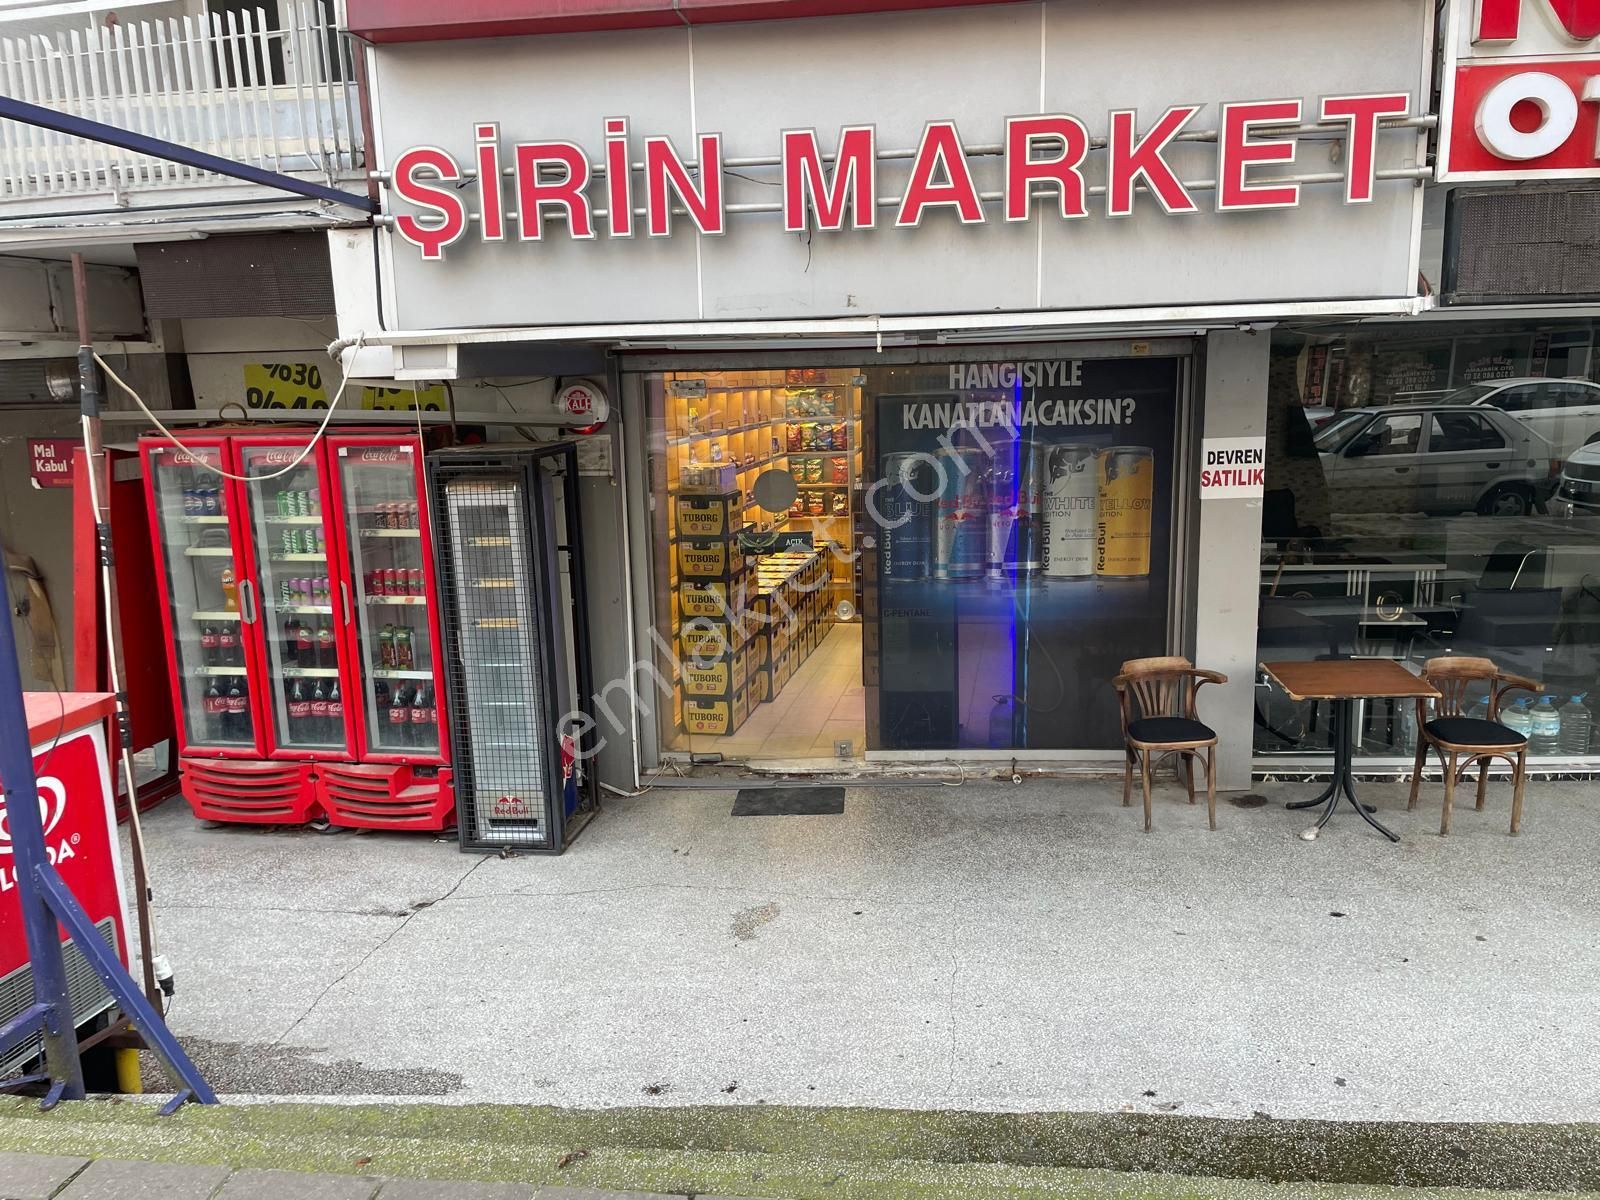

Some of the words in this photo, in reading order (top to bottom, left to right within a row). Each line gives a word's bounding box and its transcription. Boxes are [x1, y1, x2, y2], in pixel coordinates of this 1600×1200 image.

[1474, 71, 1600, 161] O
[391, 115, 726, 262] ŞİRİN
[780, 90, 1411, 233] MARKET
[903, 398, 1136, 430] KANATLANACAKSIN?
[34, 444, 55, 458] Mal
[1207, 449, 1263, 466] DEVREN
[36, 459, 68, 472] Kabul
[1201, 468, 1264, 487] SATILIK
[1044, 496, 1096, 511] WHITE
[683, 513, 718, 522] TUBORG
[1041, 521, 1051, 546] Bull
[1097, 521, 1106, 546] Bull
[685, 554, 720, 563] TUBORG
[1097, 546, 1106, 571] Red
[686, 594, 721, 604] TUBORG
[687, 634, 722, 643] TUBORG
[688, 673, 723, 682] TUBORG
[688, 712, 724, 721] TUBORG
[494, 806, 512, 815] Red
[512, 806, 529, 815] Bull
